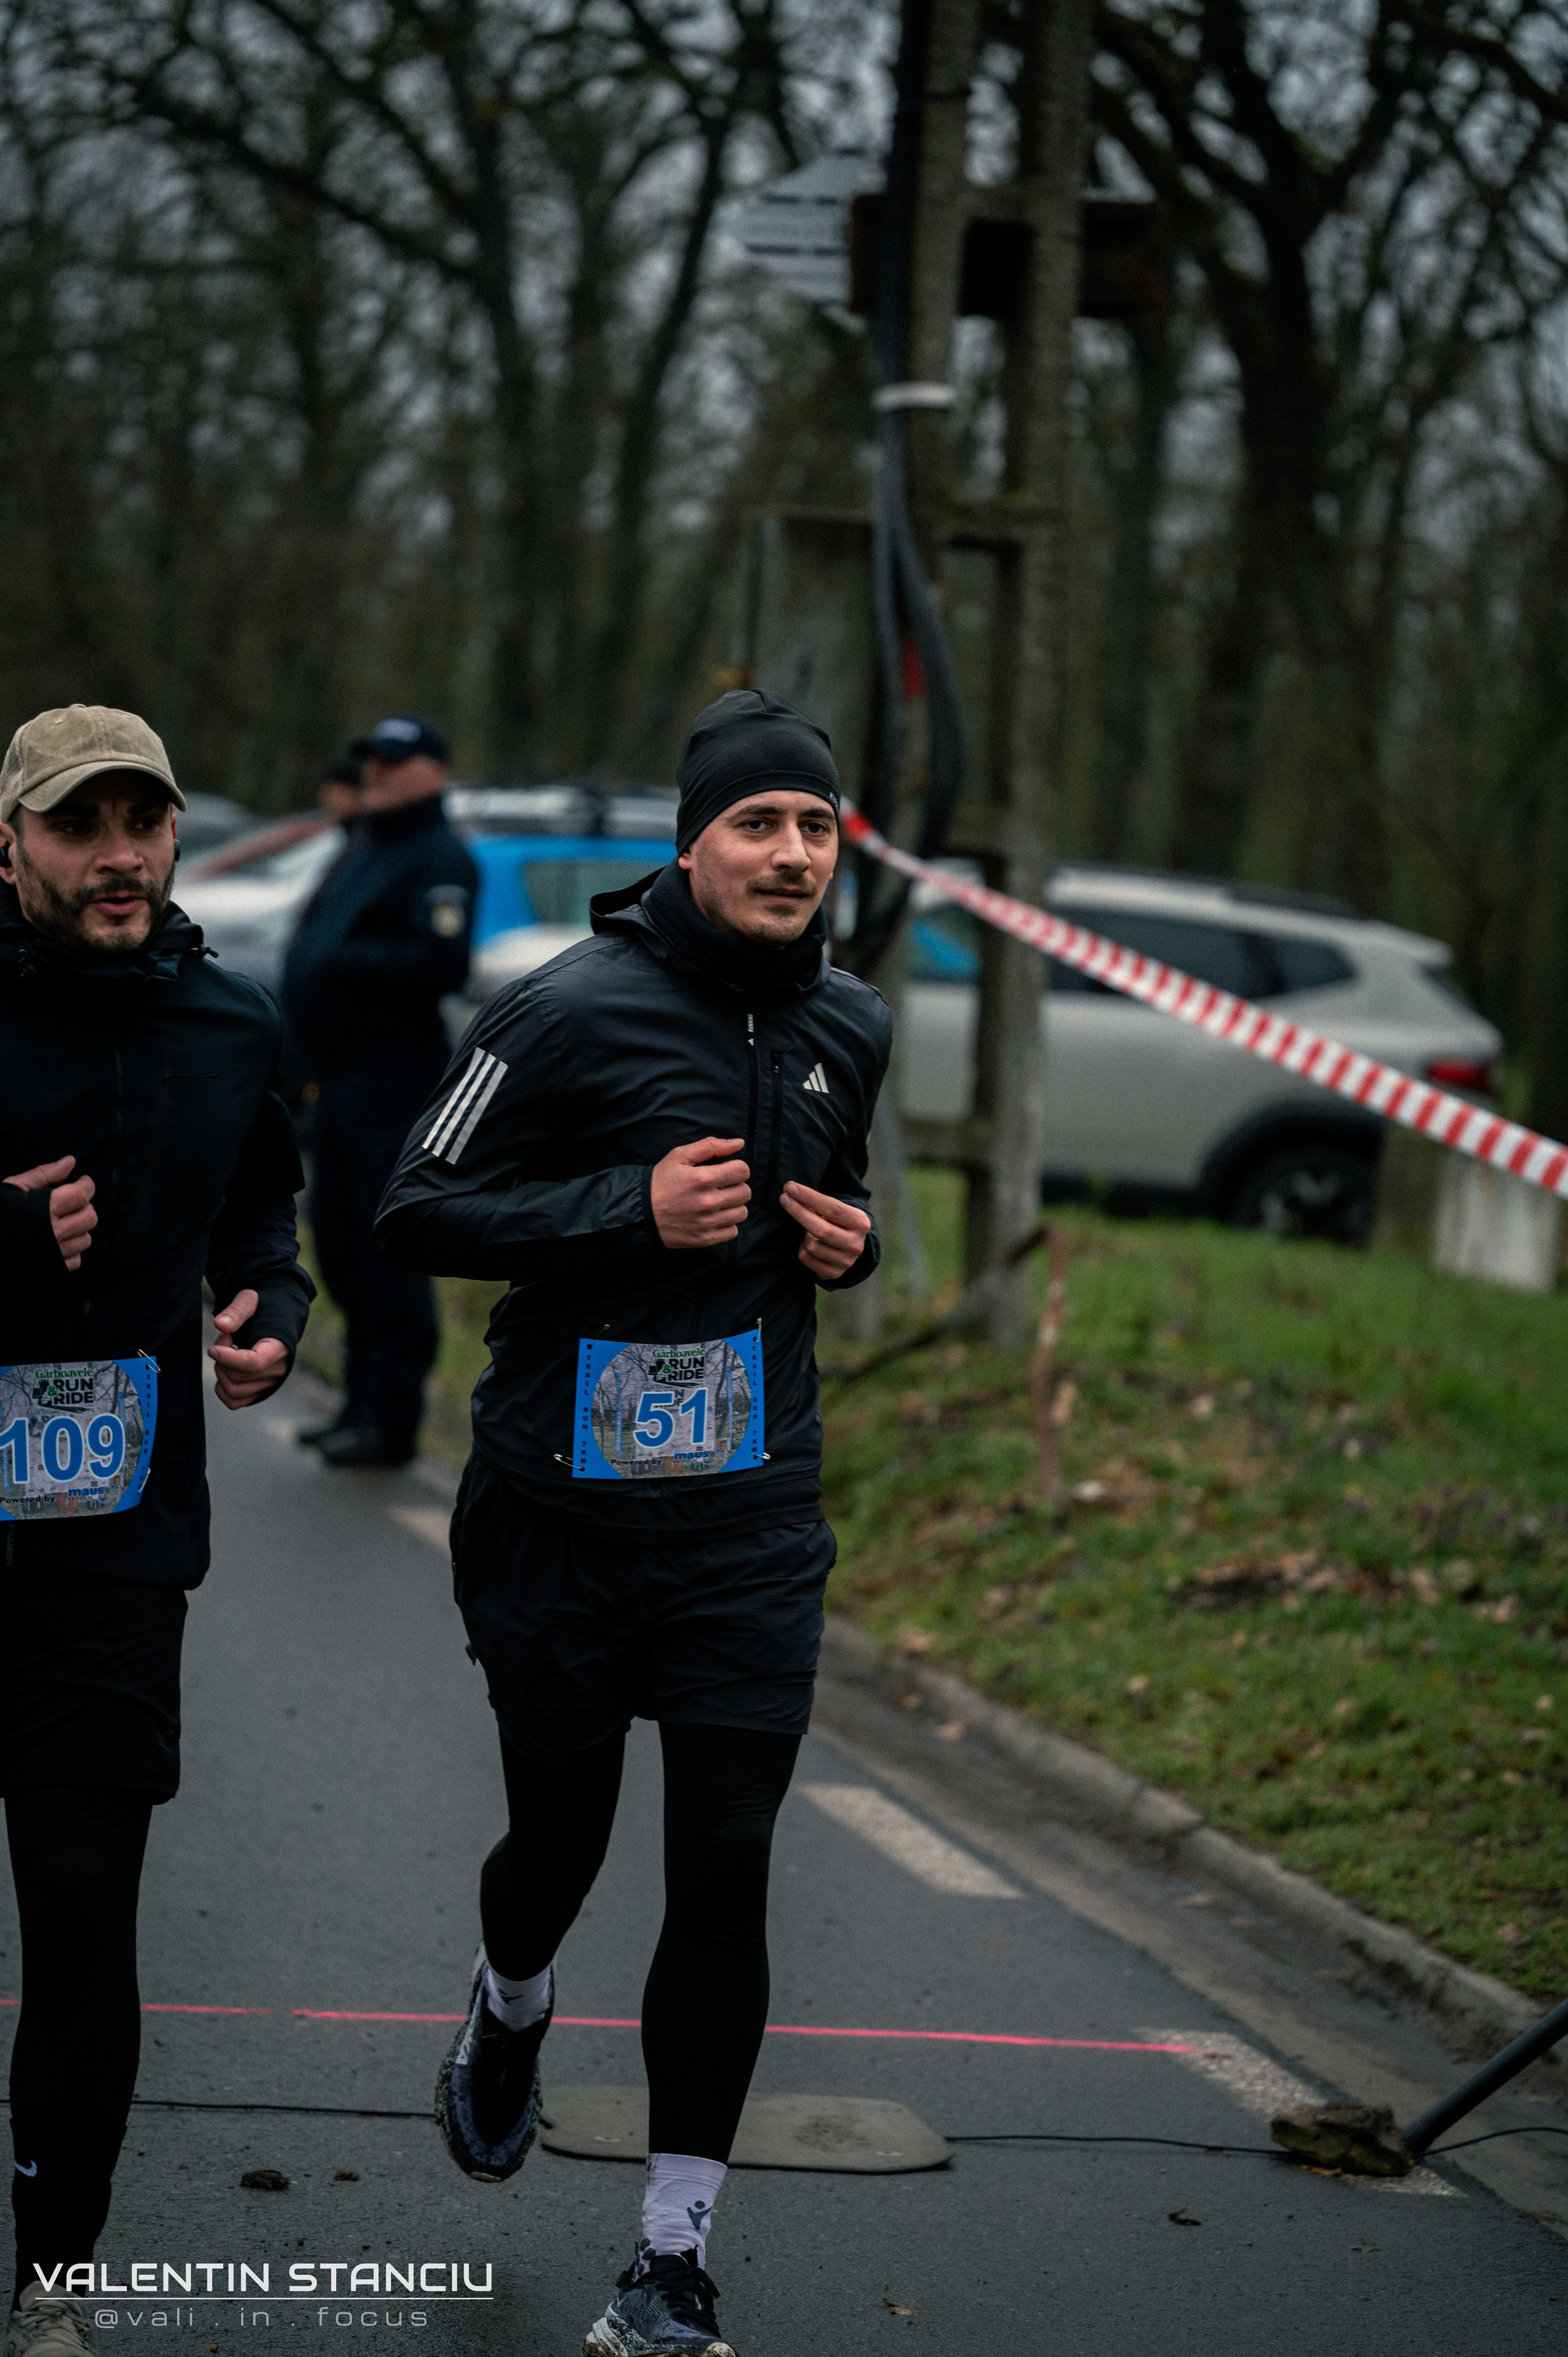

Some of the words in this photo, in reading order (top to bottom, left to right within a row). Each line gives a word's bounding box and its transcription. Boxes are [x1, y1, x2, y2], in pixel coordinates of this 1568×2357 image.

[669, 1357, 704, 1370] RUN
[35, 1368, 92, 1378] Gârboavele
[663, 1365, 672, 1374] &
[668, 1368, 704, 1381] RIDE
[53, 1378, 94, 1391] RUN
[47, 1386, 58, 1397] &
[54, 1391, 94, 1405] RIDE
[633, 1387, 708, 1447] 51
[0, 1413, 126, 1483] 109
[674, 1451, 709, 1460] maus
[0, 1495, 41, 1504] Powered
[68, 1487, 104, 1496] maus
